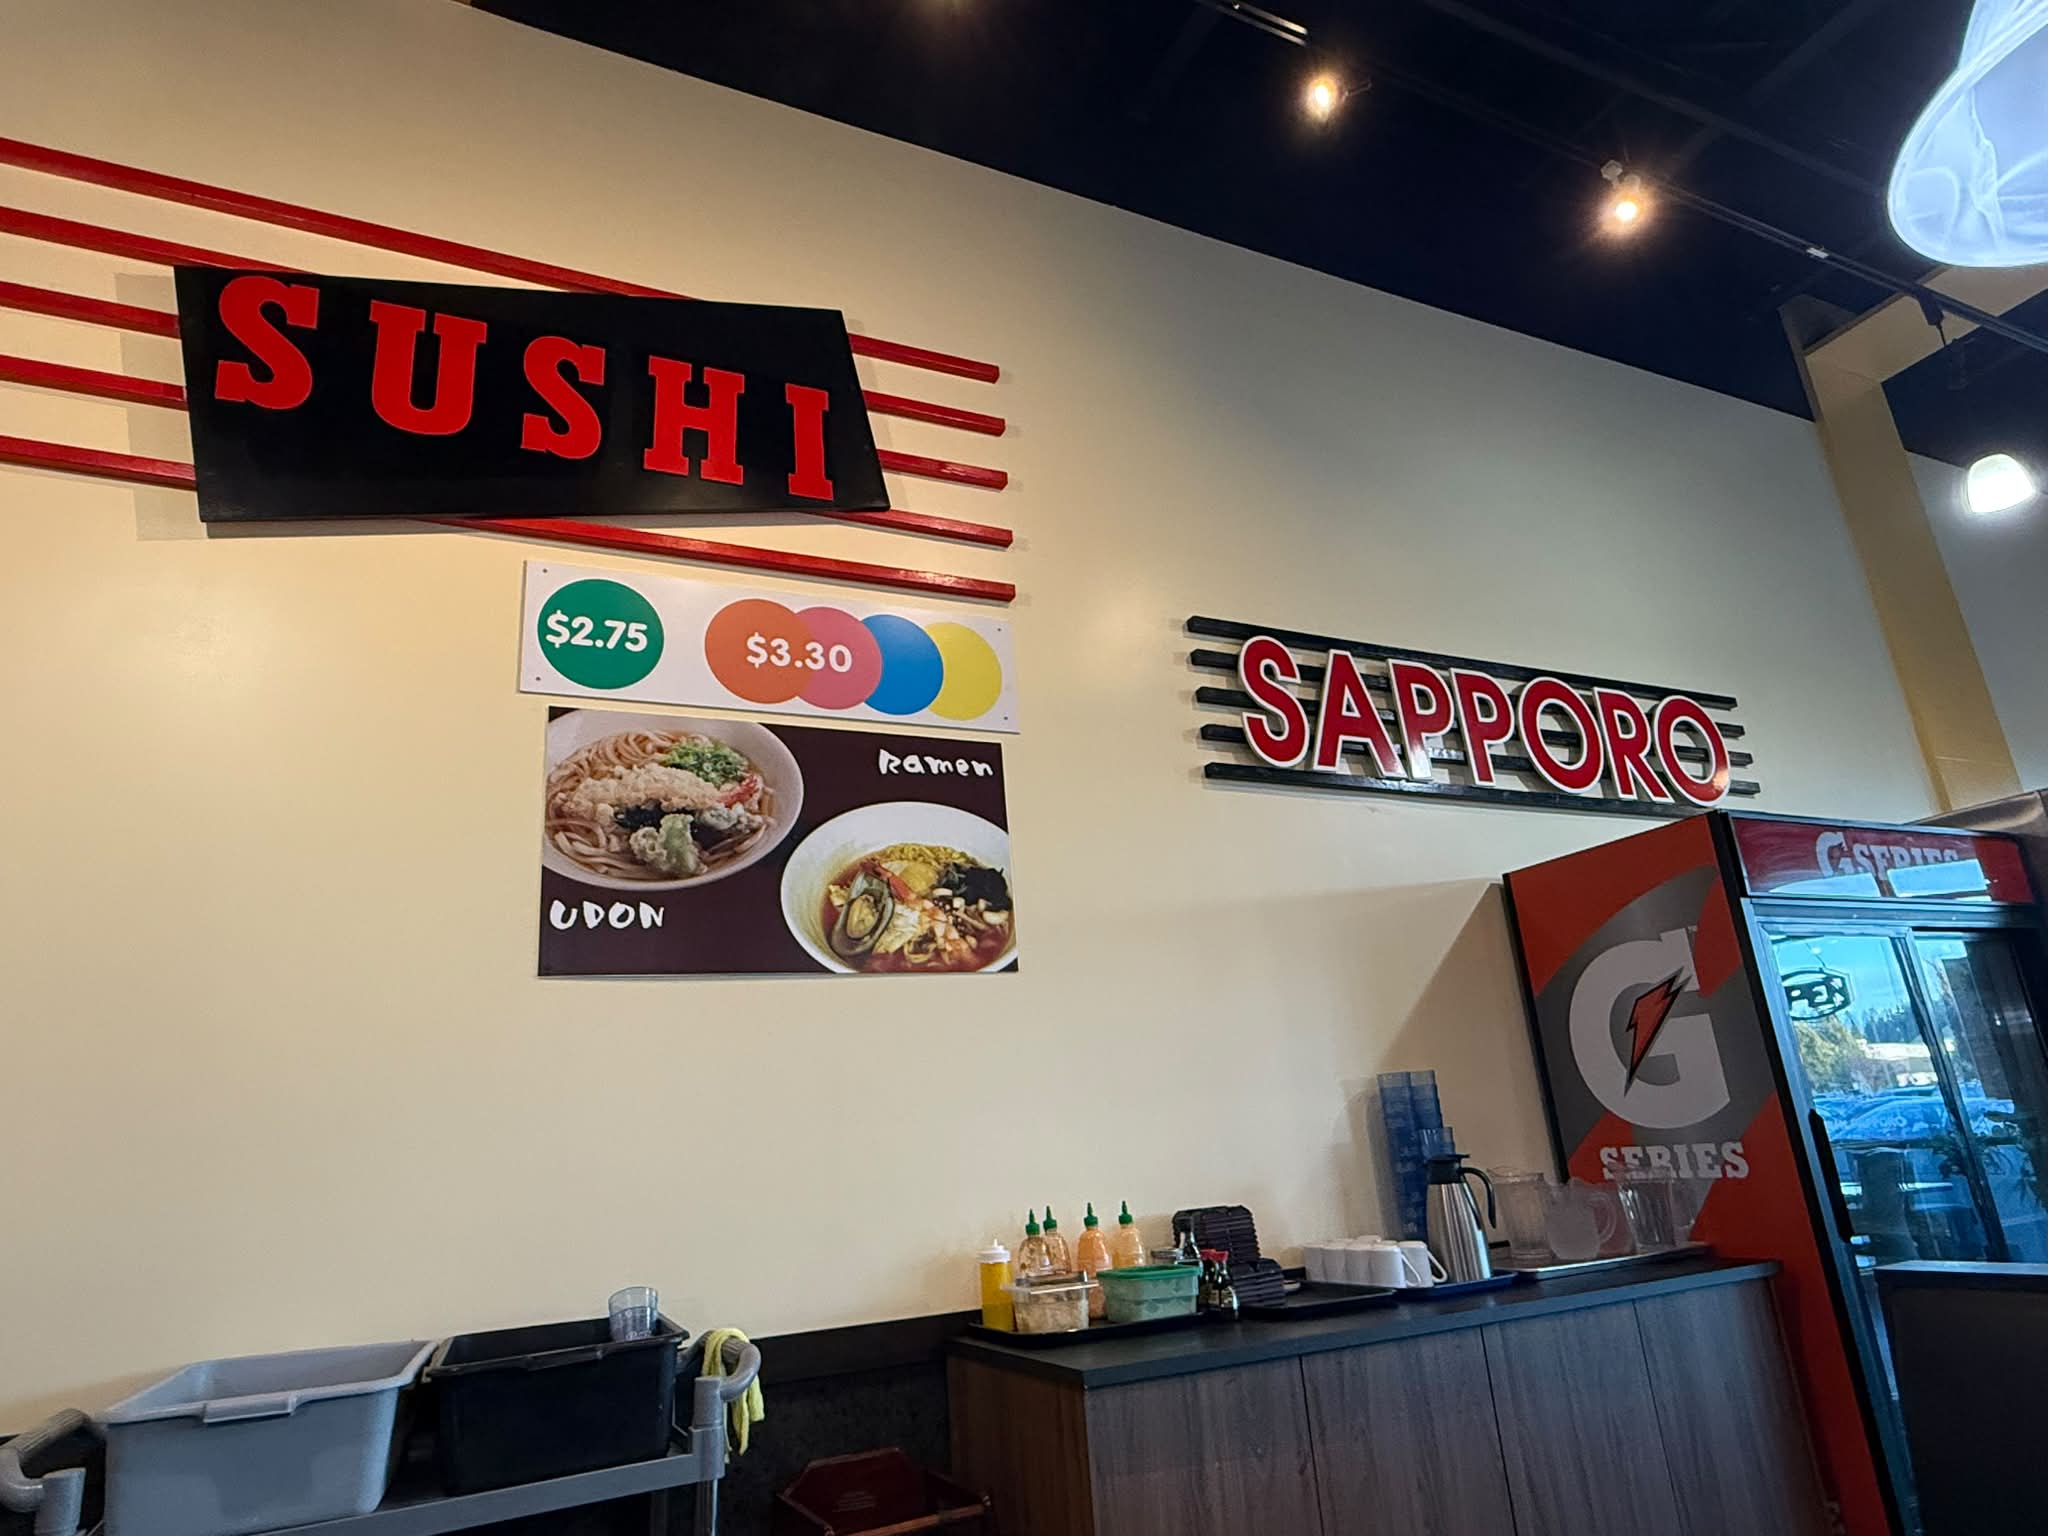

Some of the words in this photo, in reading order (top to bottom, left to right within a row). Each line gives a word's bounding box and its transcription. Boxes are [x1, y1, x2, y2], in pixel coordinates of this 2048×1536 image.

[214, 275, 834, 501] SUSHI
[545, 609, 648, 653] $2.75
[745, 632, 853, 673] $3.30
[1237, 635, 1731, 806] SAPPORO
[878, 748, 994, 777] Ramen
[1852, 843, 1959, 881] SER
[548, 899, 665, 930] UDON
[1784, 976, 1849, 1012] PEN
[1568, 927, 1731, 1130] G
[1599, 1141, 1750, 1181] SERIES
